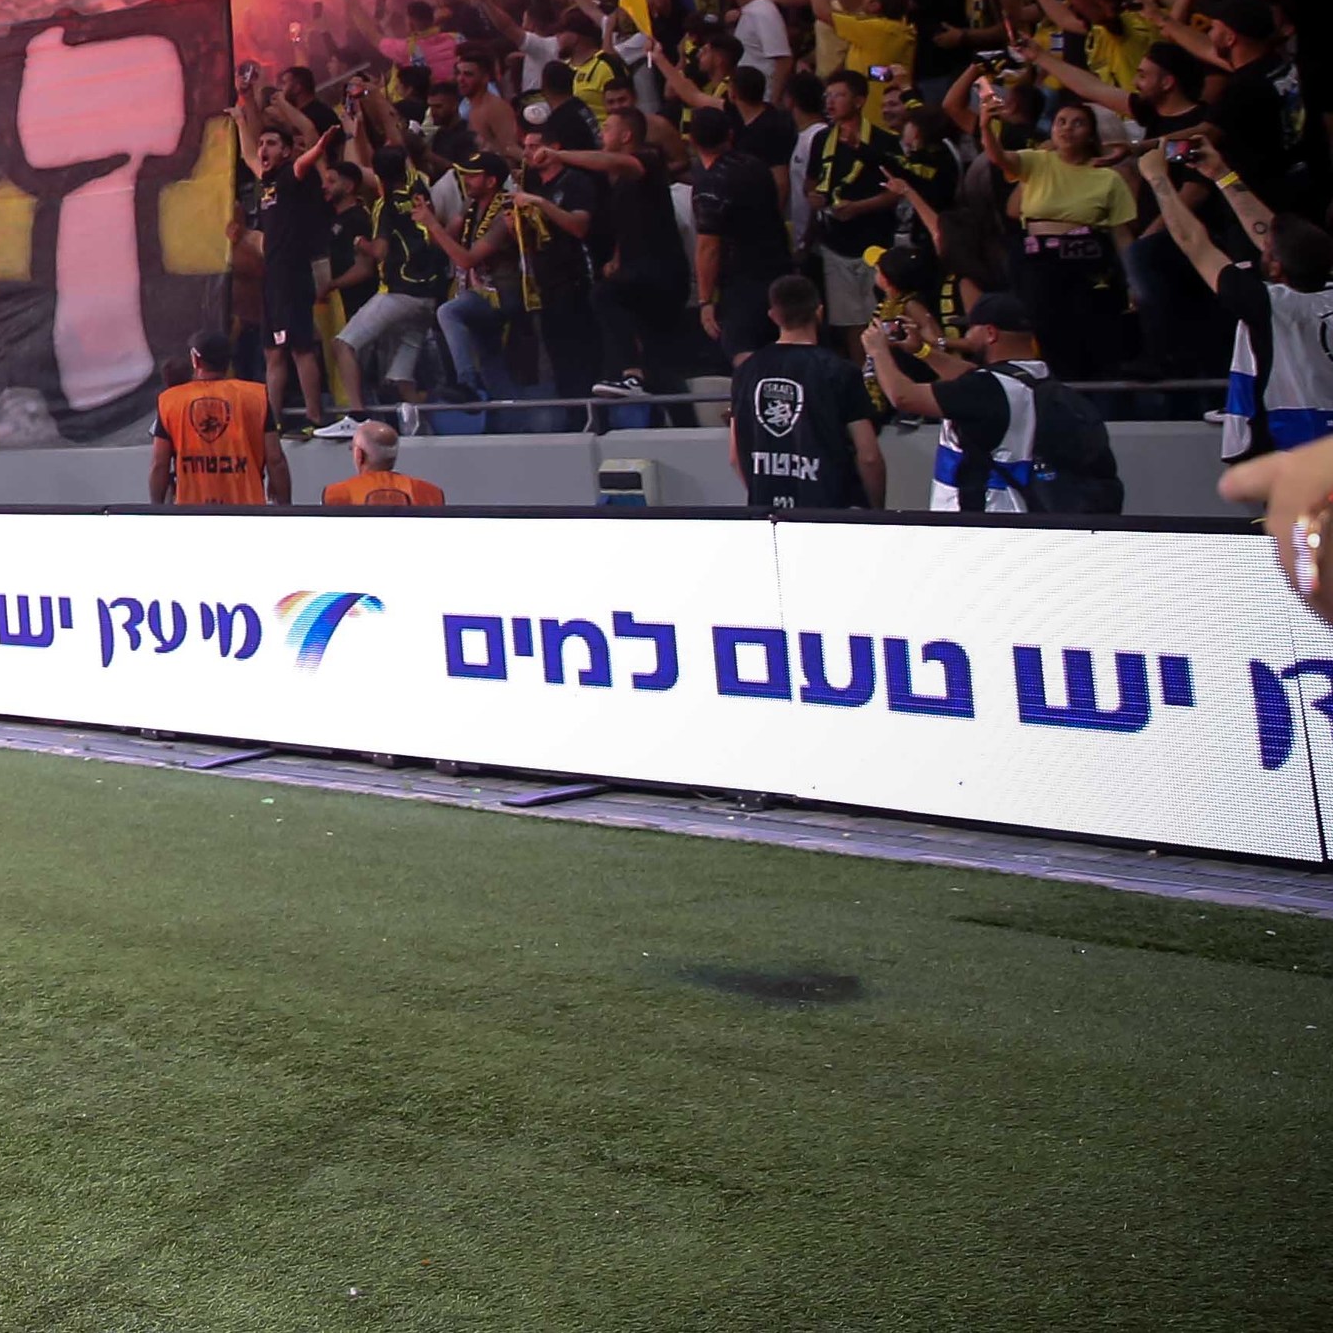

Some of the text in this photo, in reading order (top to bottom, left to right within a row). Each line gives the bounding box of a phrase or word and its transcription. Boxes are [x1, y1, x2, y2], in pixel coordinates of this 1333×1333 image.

[751, 452, 820, 481] אבטח
[96, 596, 187, 668] עדן
[200, 601, 262, 660] מי
[442, 611, 678, 692] למים
[711, 624, 975, 720] טעם
[1013, 643, 1195, 733] יש
